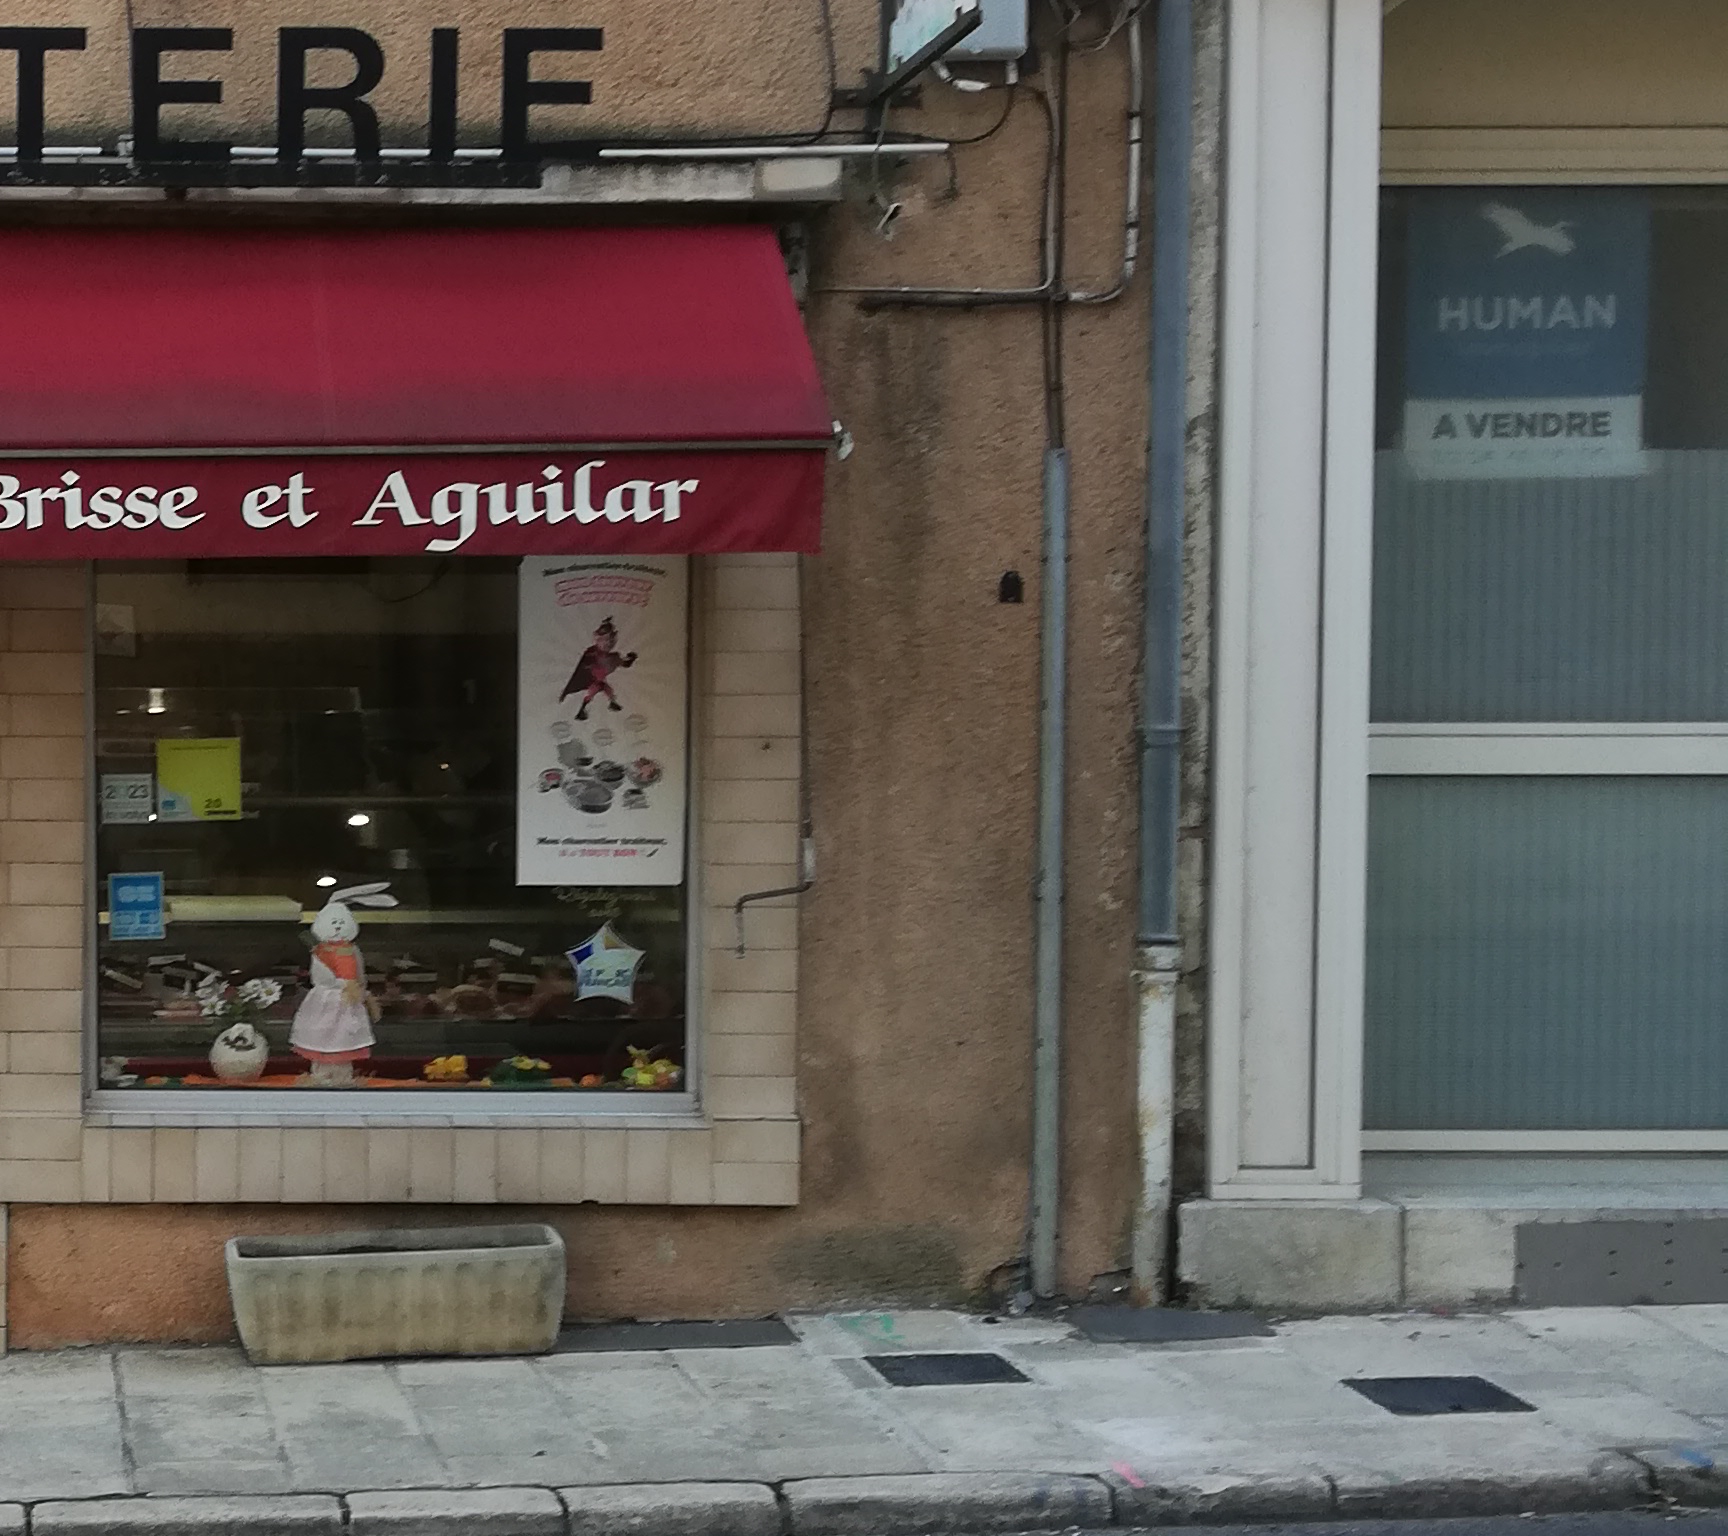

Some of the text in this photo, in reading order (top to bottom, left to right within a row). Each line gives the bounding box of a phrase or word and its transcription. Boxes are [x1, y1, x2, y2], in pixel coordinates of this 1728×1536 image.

[1438, 294, 1617, 331] HUMAN
[1432, 410, 1613, 440] A VENDRE
[240, 471, 321, 532] et
[351, 460, 701, 553] Aguilar
